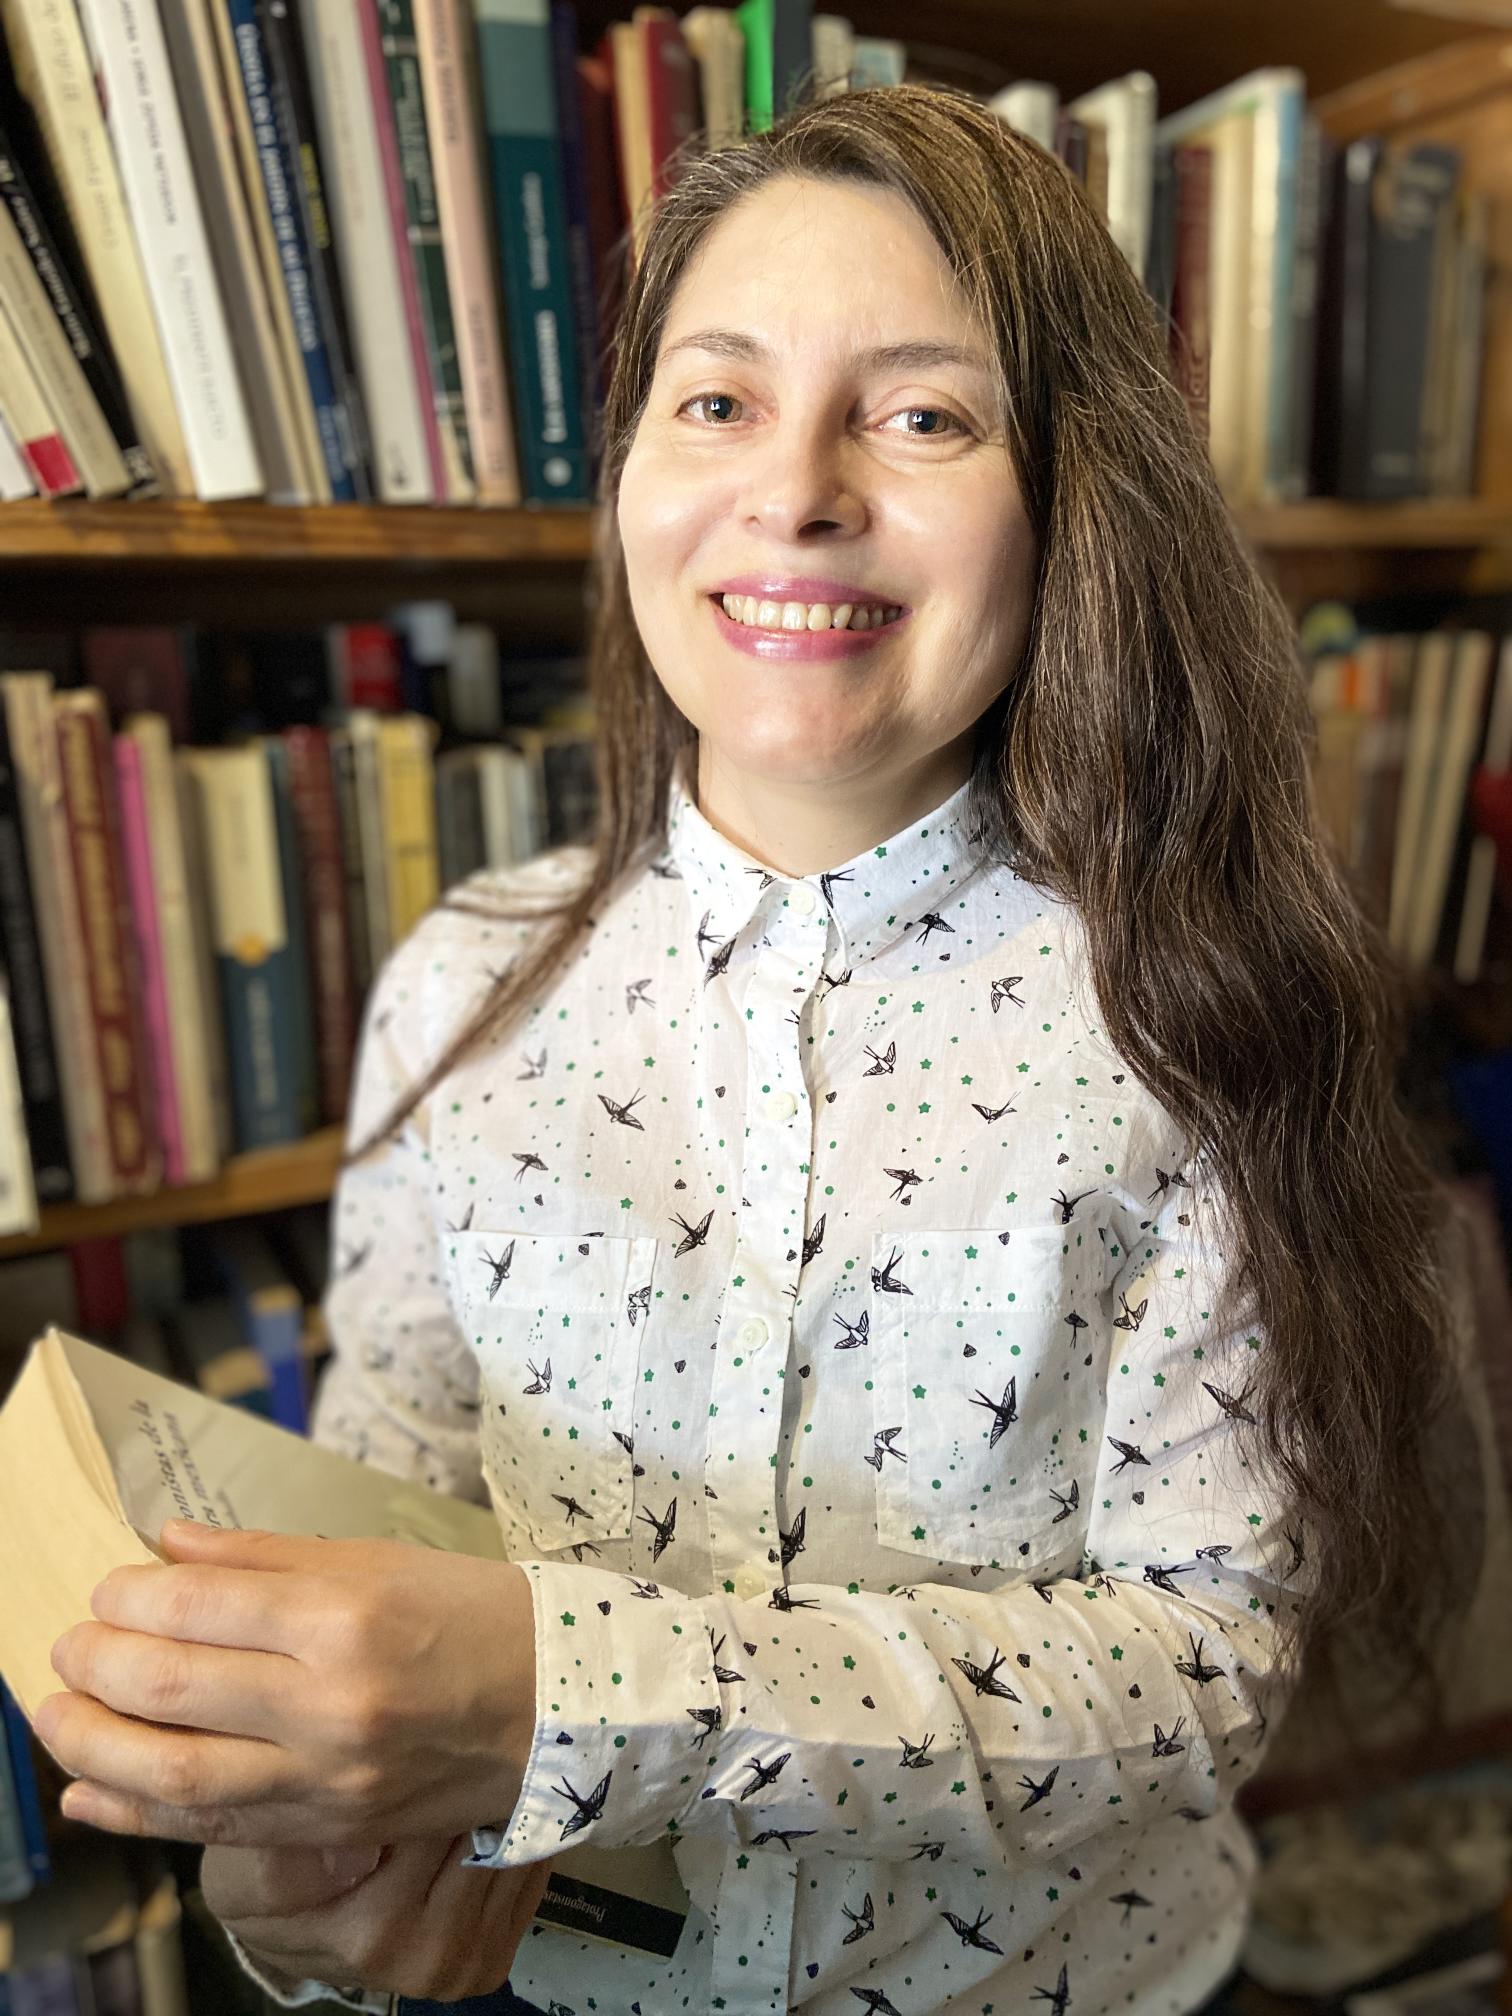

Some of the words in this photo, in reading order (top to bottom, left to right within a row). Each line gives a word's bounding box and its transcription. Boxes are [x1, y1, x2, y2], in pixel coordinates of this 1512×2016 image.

[129, 1399, 152, 1418] la
[138, 1420, 162, 1446] de
[154, 1449, 194, 1520] onistas
